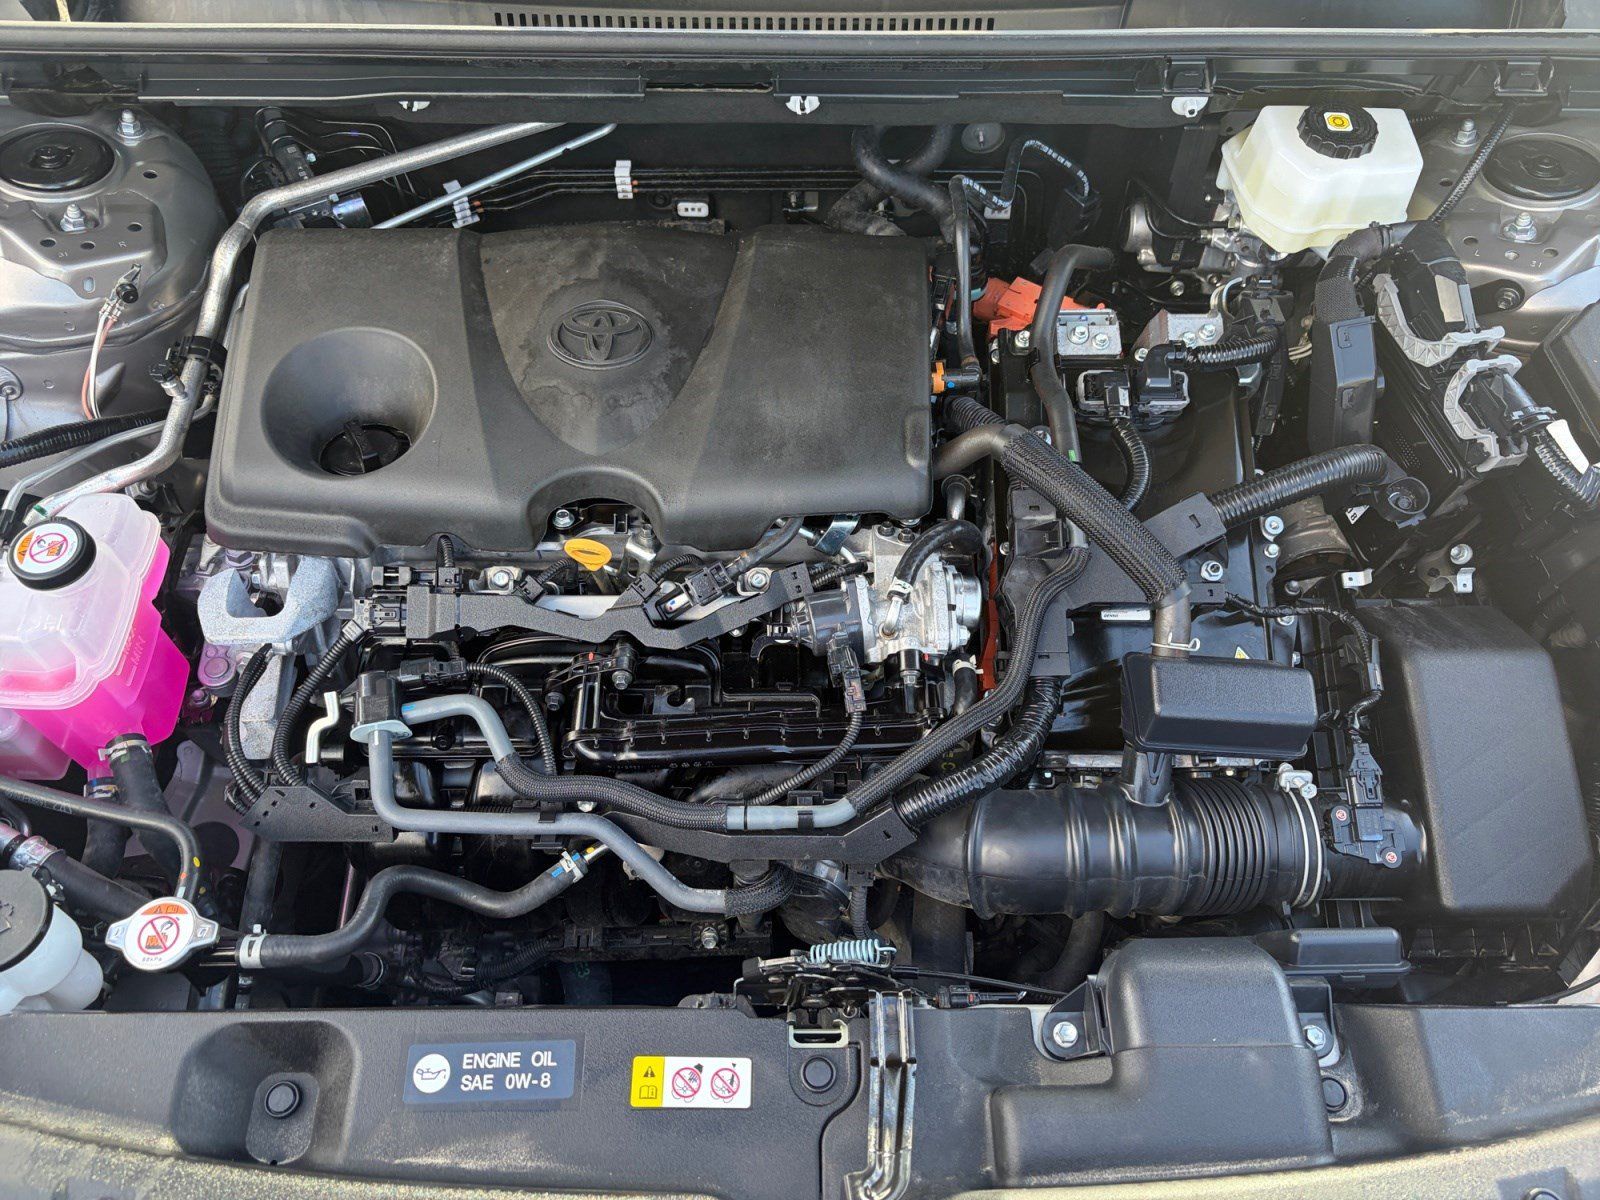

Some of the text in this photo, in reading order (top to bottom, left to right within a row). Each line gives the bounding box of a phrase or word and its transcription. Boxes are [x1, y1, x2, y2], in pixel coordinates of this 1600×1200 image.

[462, 1050, 557, 1069] ENGINE OIL
[460, 1072, 551, 1092] SAE 0W-8
